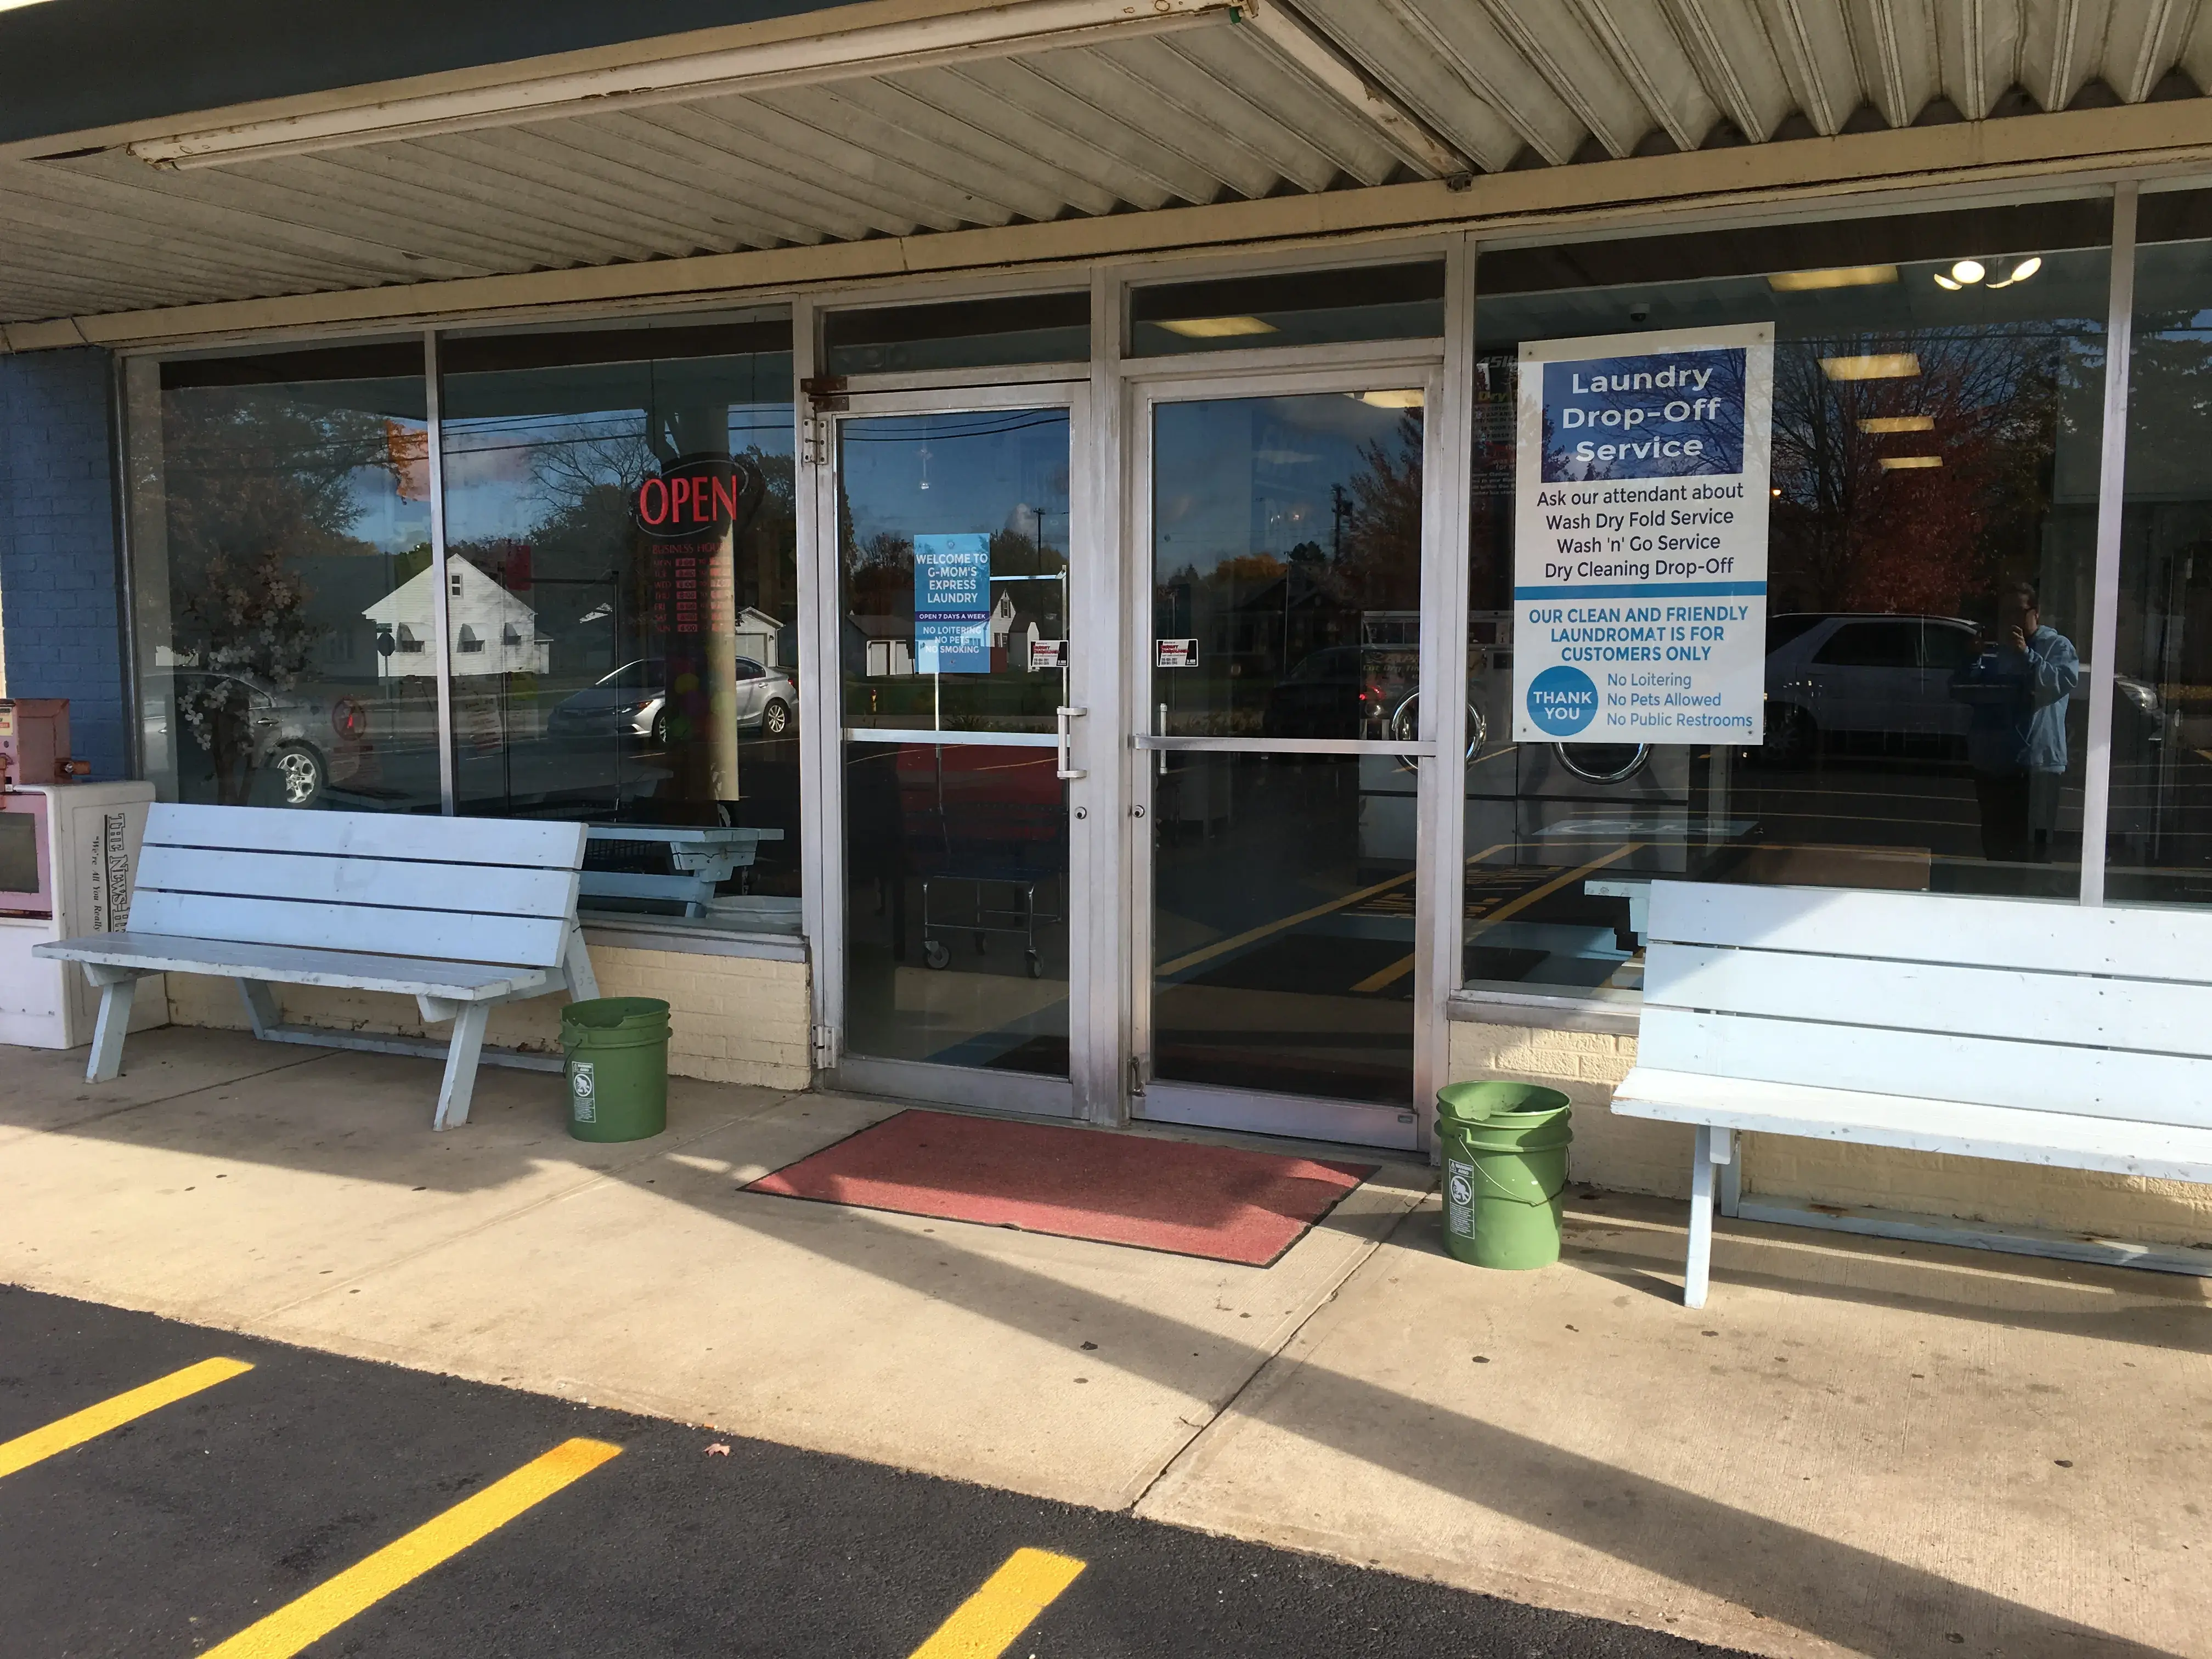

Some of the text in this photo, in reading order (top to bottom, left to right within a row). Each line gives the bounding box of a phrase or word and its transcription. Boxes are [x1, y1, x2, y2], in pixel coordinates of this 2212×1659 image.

[1572, 365, 1713, 394] Laundry
[1563, 397, 1721, 430] Drop-Off
[1576, 436, 1703, 462] Service
[640, 475, 737, 524] OPEN
[1537, 483, 1743, 507] Ask our attendant about
[1547, 509, 1733, 532] Wash Dry Fold Service
[1558, 534, 1720, 554] Wash 'n' Go Service
[916, 554, 988, 564] WELCOME TO
[928, 567, 977, 577] G-MOM'S
[1545, 558, 1734, 581] Dry Cleaning Drop-Off
[930, 580, 976, 590] EXPRESS
[928, 593, 978, 603] LAUNDRY
[1530, 606, 1748, 624] OUR CLEAN AND FRIENDLY
[1551, 626, 1724, 642] LAUNDROMAT IS FOR
[1561, 646, 1711, 661] CUSTOMERS ONLY
[1608, 673, 1691, 690] No Loitering
[1533, 691, 1592, 704] THANK
[1607, 692, 1721, 707] No Pets Allowed
[1544, 708, 1580, 720] YOU
[1607, 713, 1752, 727] No Public Restrooms
[94, 905, 102, 932] Really
